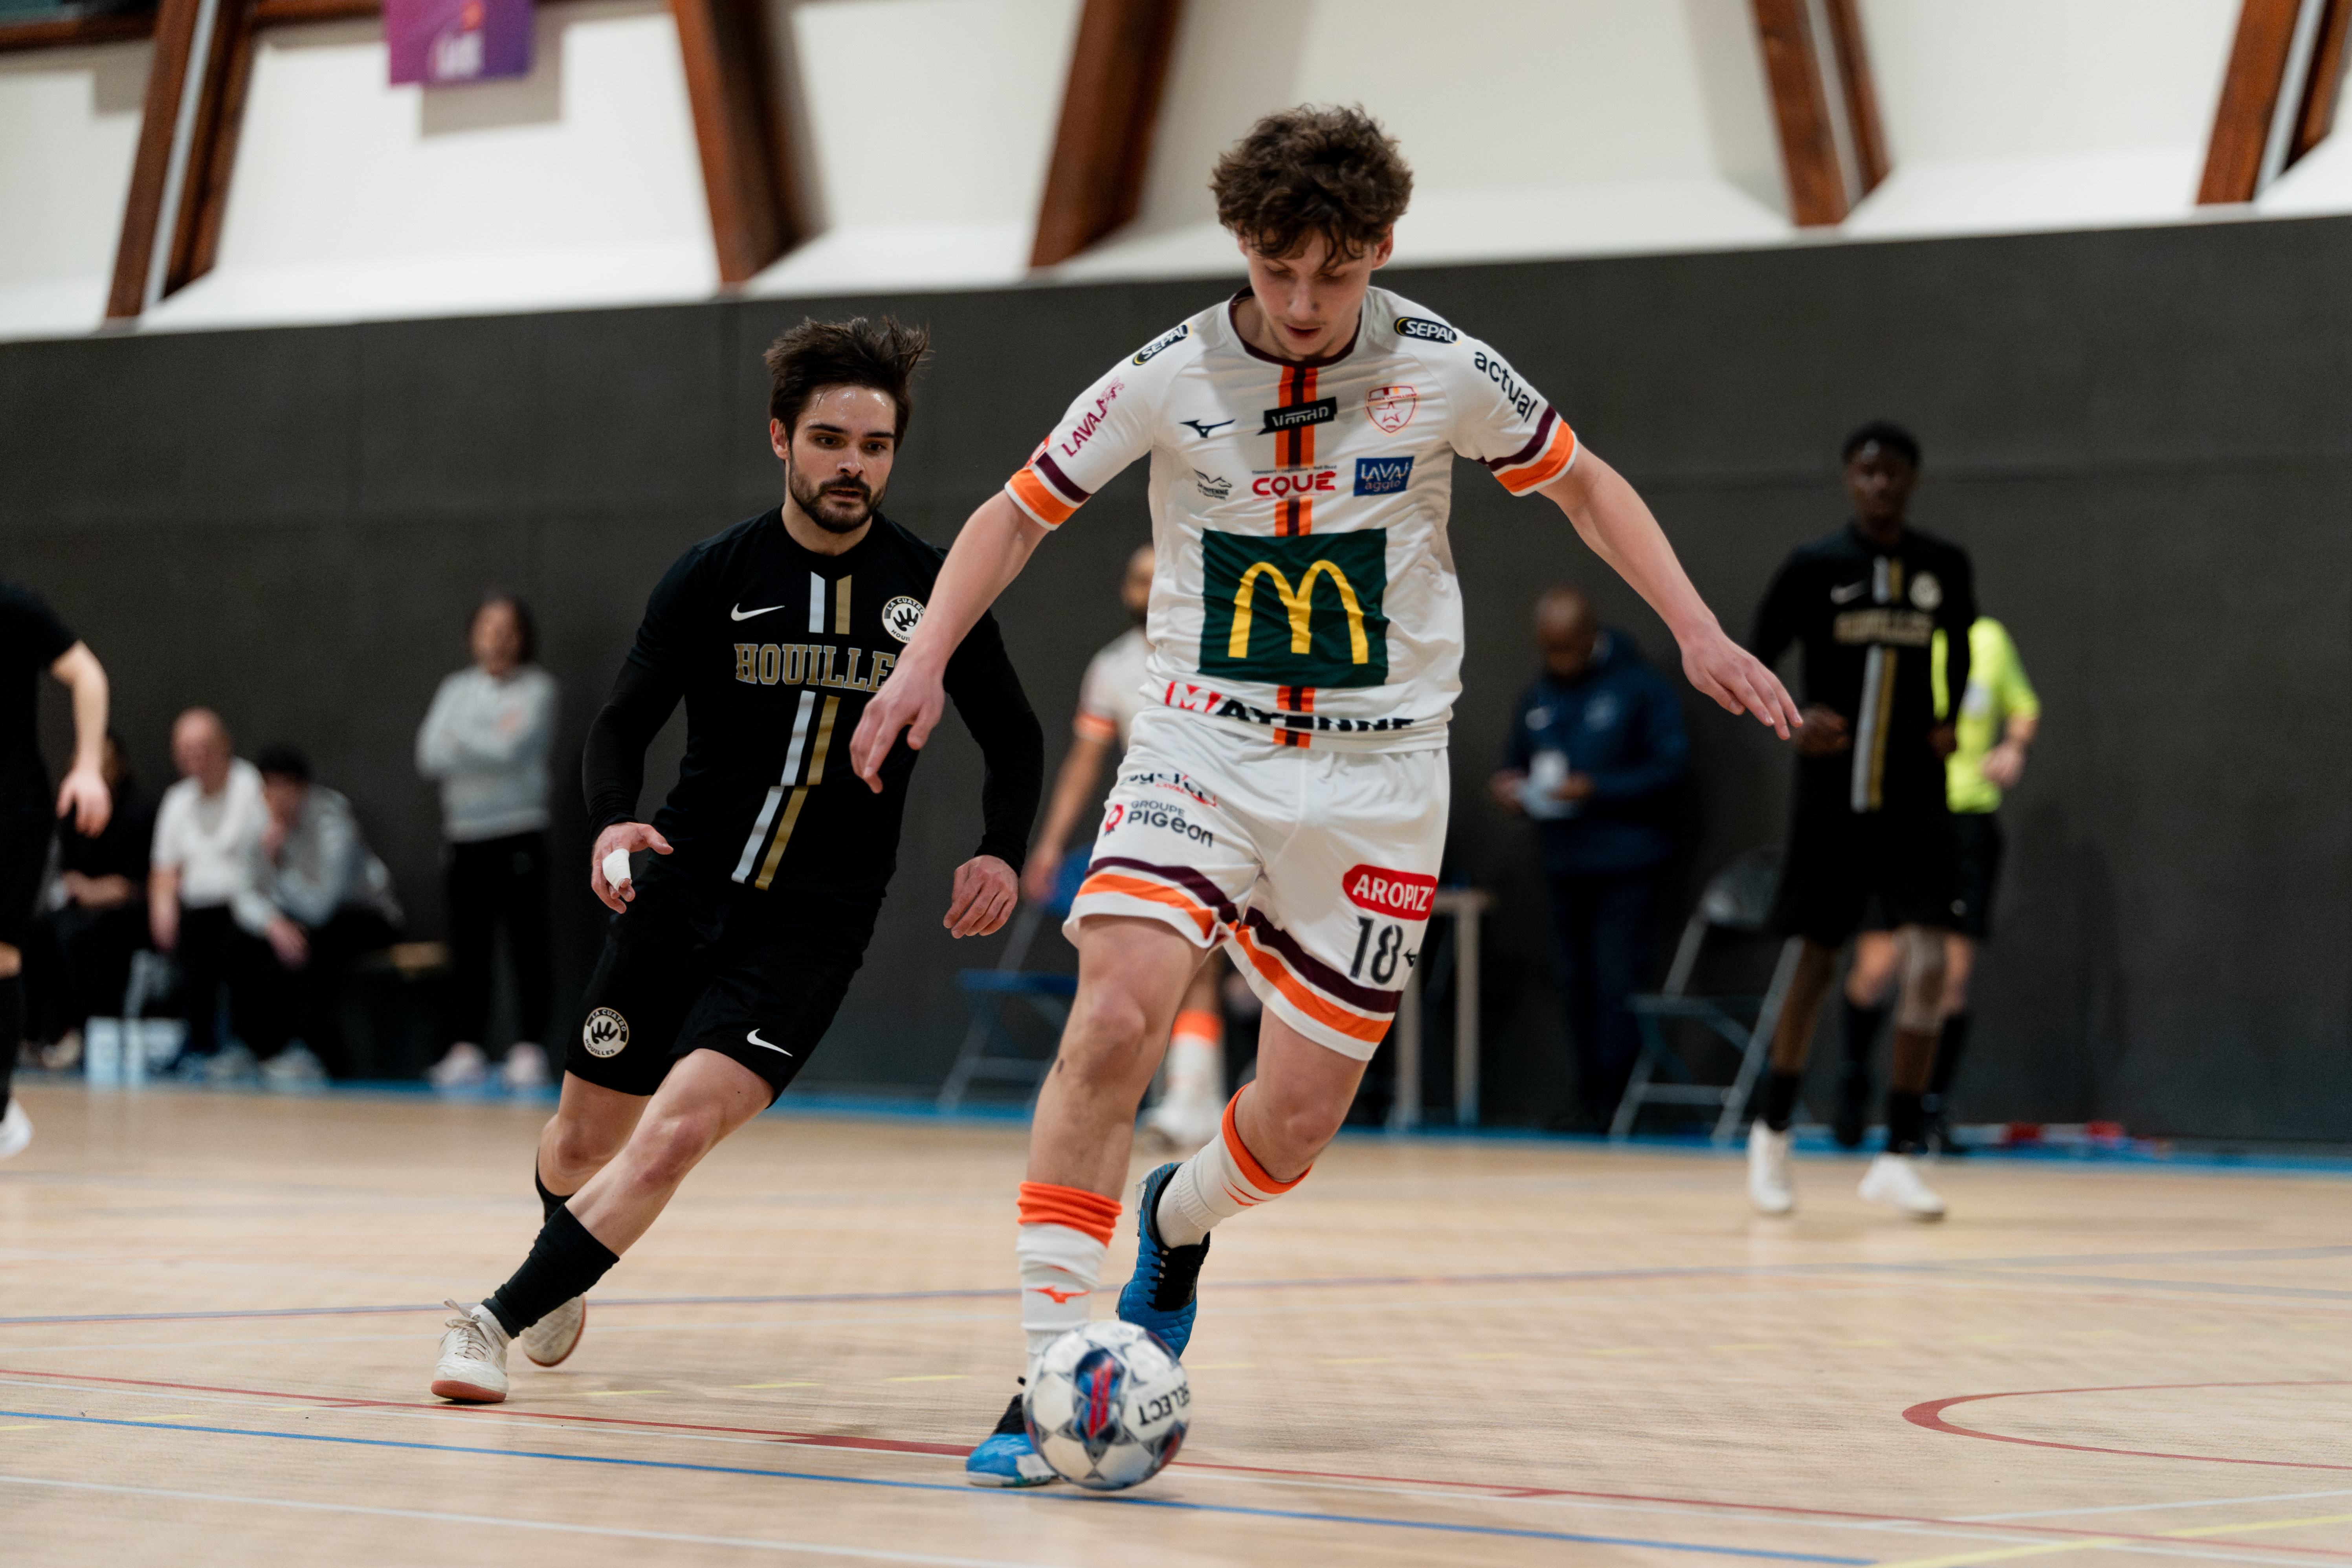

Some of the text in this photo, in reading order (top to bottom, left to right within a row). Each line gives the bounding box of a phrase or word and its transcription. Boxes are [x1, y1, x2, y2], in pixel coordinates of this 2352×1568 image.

[1141, 326, 1189, 360] SEPAL
[1405, 320, 1458, 344] SEPAL
[1474, 351, 1538, 424] actual
[1364, 479, 1402, 492] agglo
[887, 598, 925, 615] LA CUATRO
[734, 643, 899, 693] HOUILLE
[1131, 800, 1185, 817] GROUPE
[1348, 914, 1404, 985] 18
[601, 1008, 627, 1032] CUATRO
[585, 1038, 615, 1056] HOUILLES
